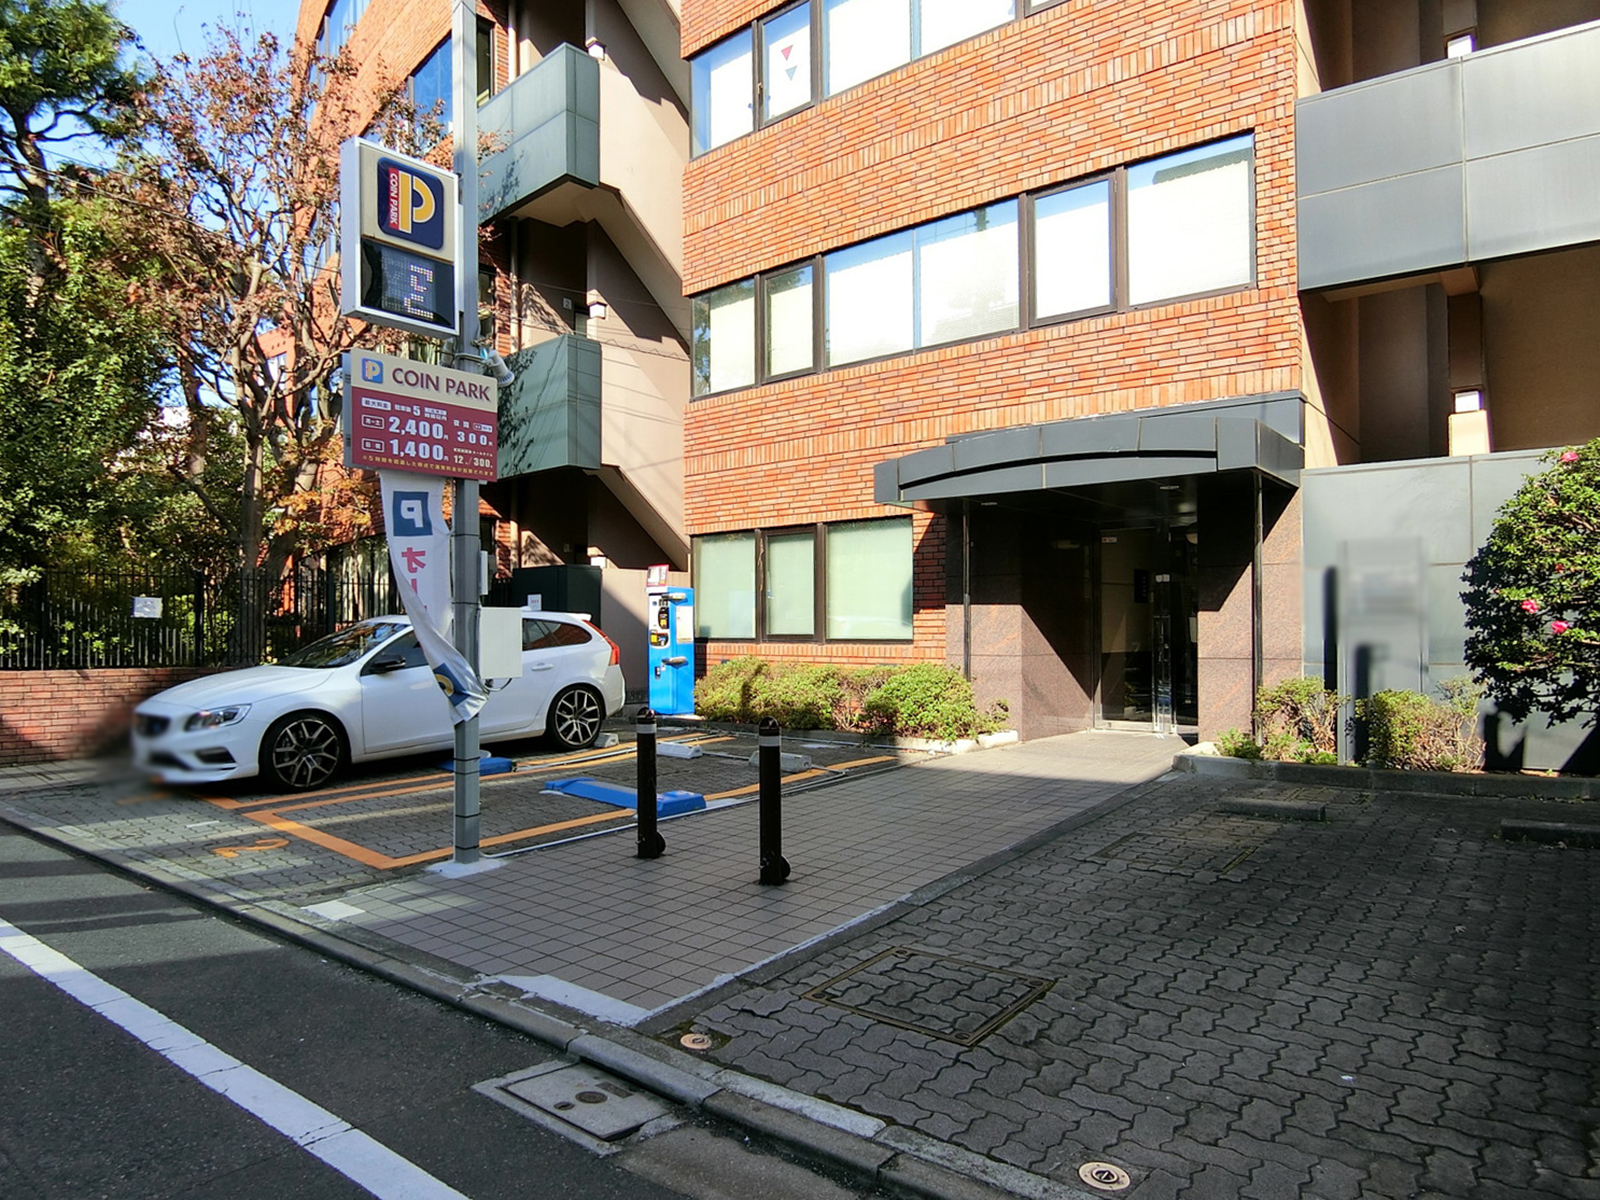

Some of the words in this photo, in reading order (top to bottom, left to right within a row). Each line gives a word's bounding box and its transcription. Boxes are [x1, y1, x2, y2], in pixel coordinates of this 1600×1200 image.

[388, 172, 399, 200] COIN
[388, 199, 399, 225] PARK
[398, 170, 436, 234] P
[392, 367, 440, 392] COIN
[445, 377, 491, 402] PARK
